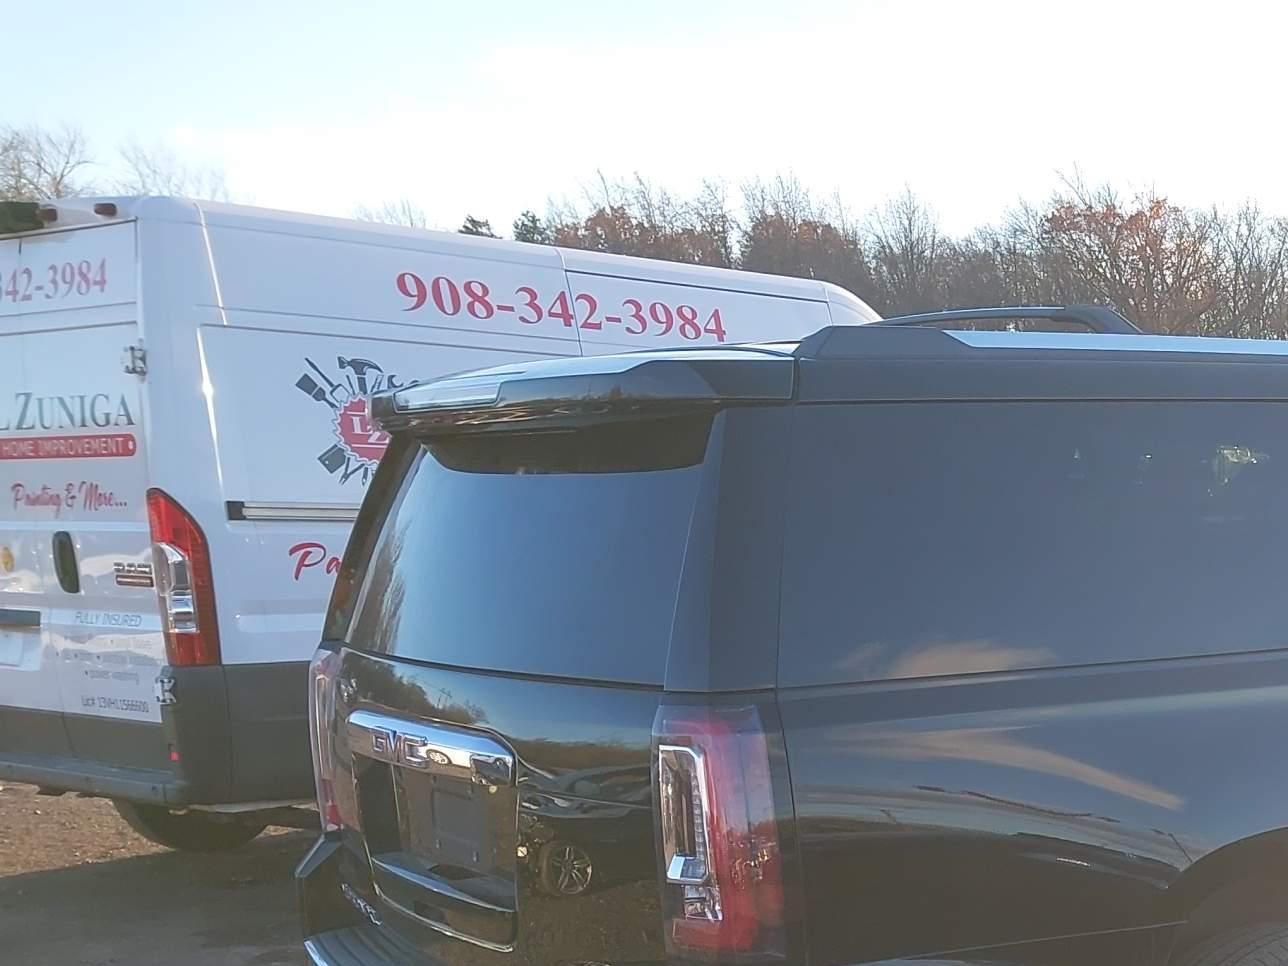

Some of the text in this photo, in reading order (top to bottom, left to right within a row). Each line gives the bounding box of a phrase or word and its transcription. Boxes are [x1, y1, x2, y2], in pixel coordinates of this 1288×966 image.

[396, 271, 727, 342] 908-342-3984
[15, 391, 136, 431] ZUNIGA
[371, 728, 430, 769] GMC
